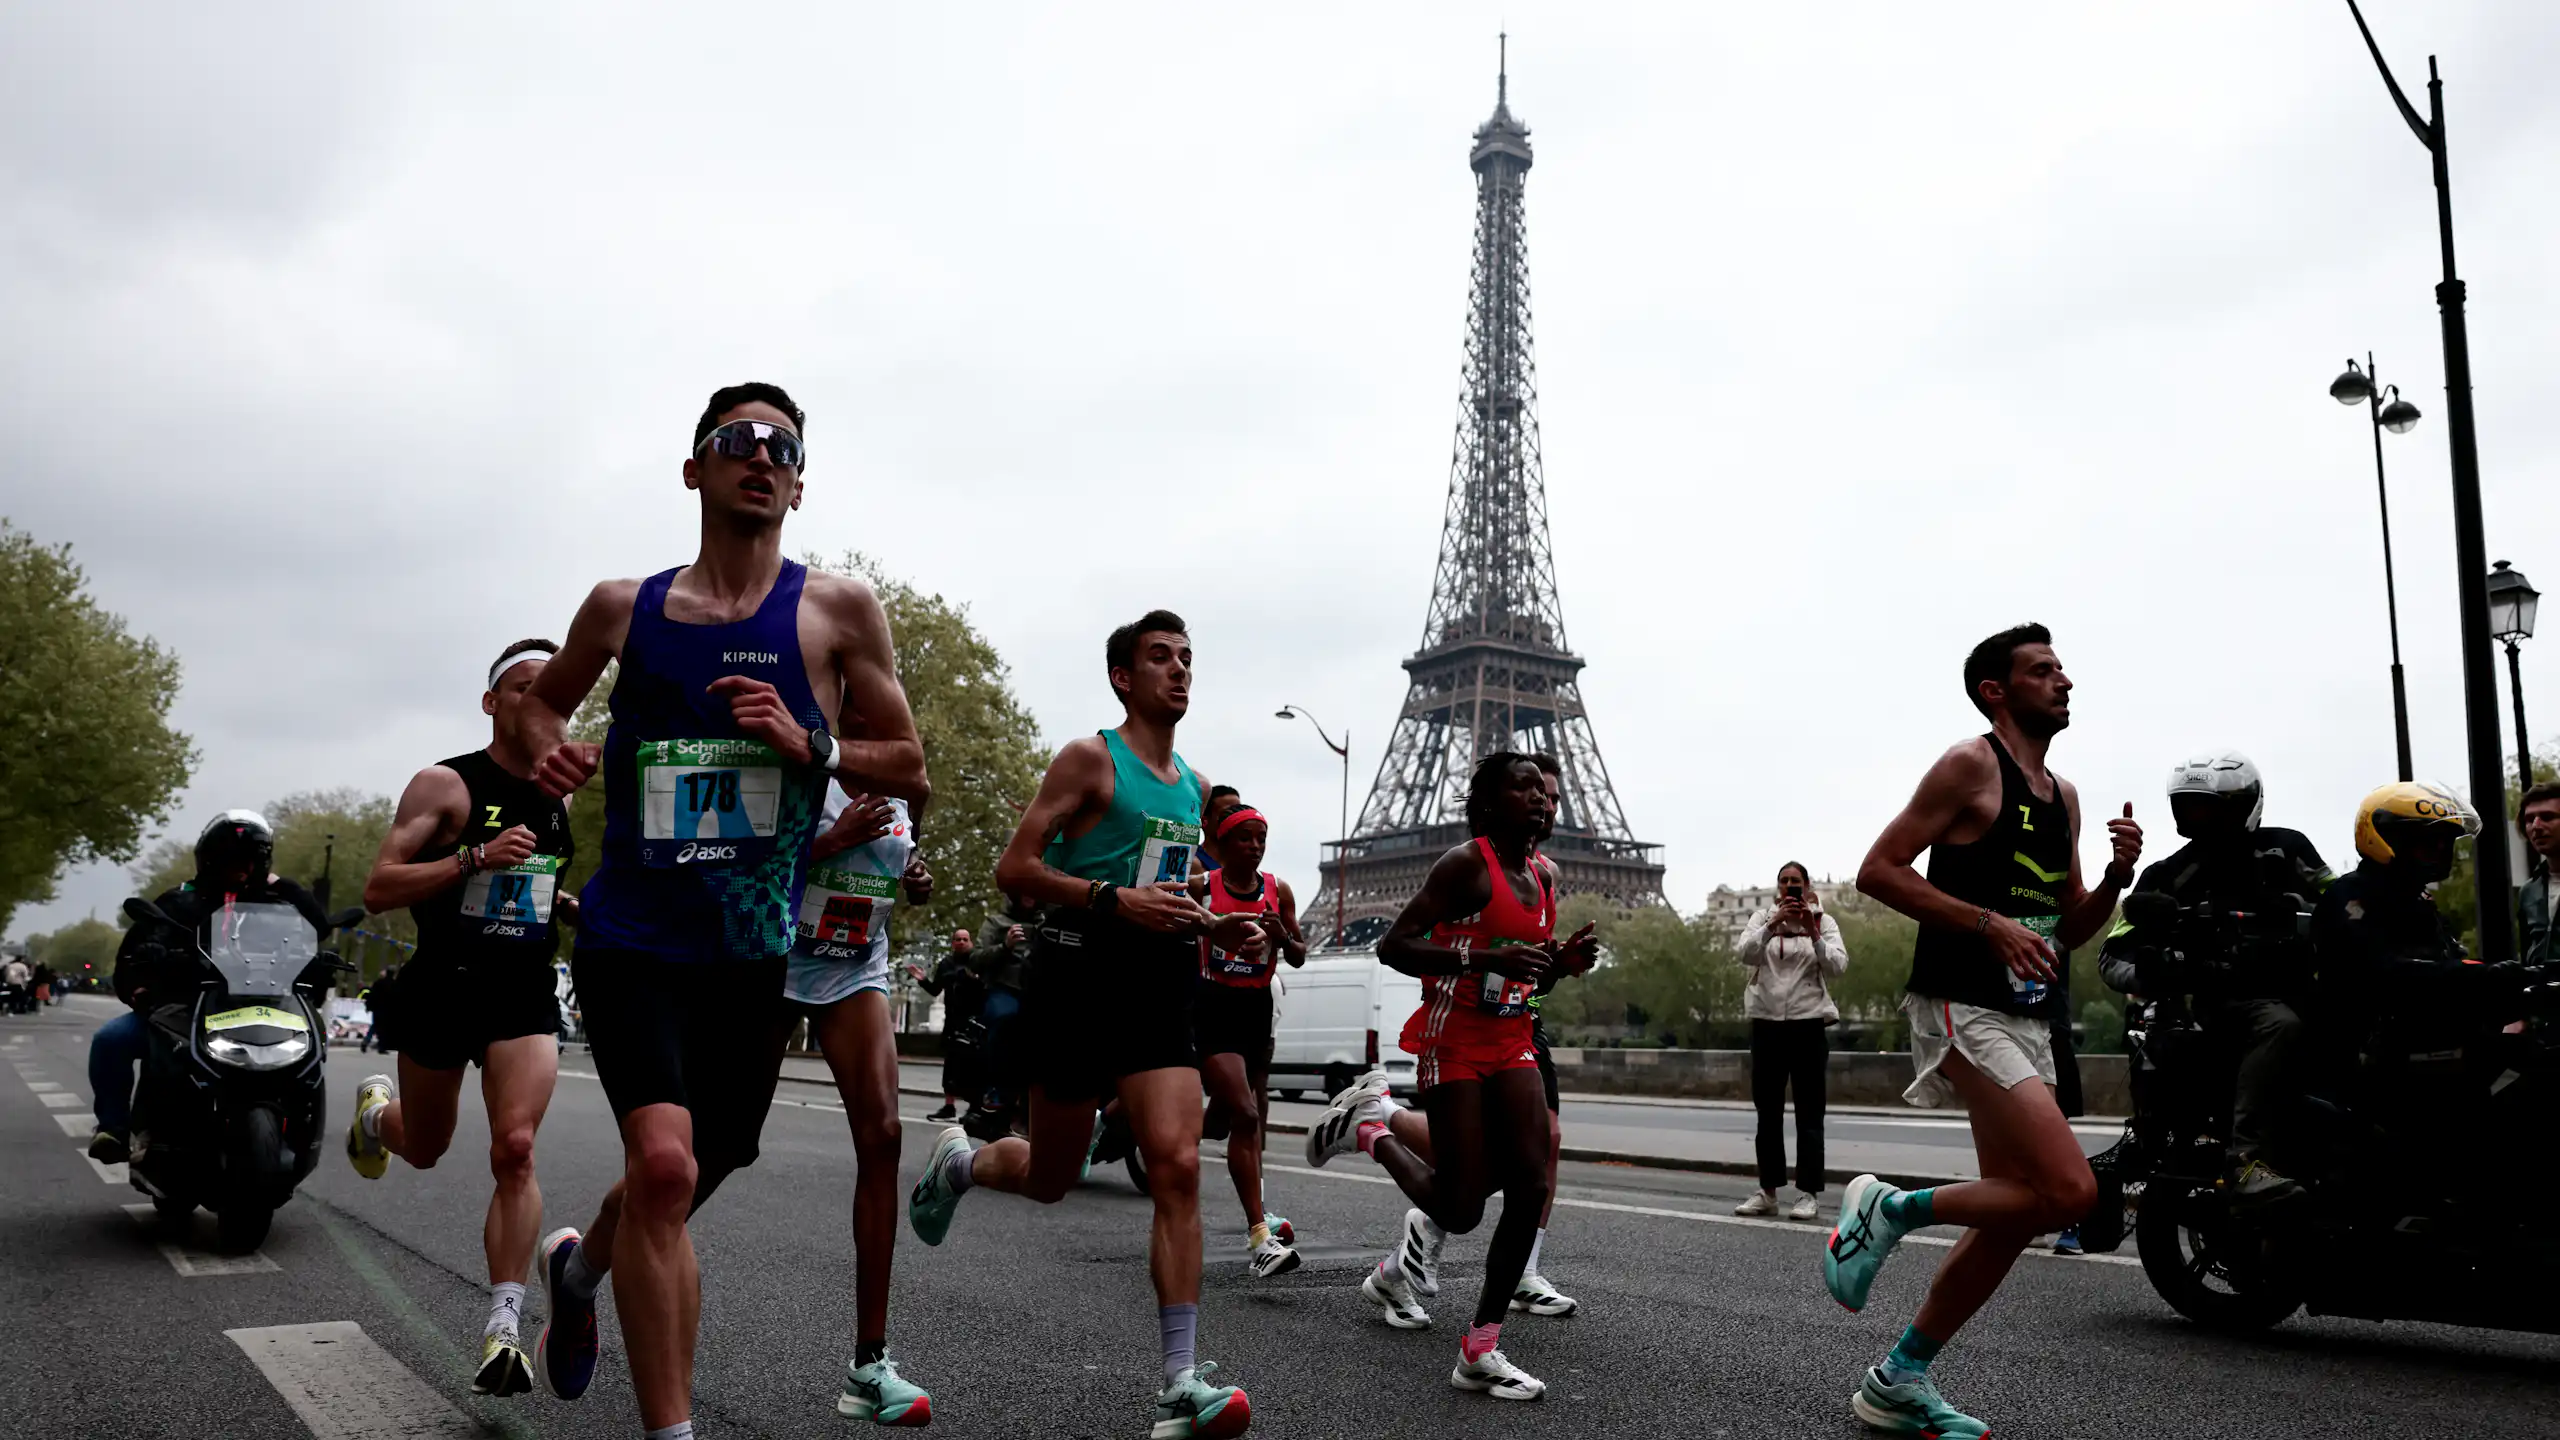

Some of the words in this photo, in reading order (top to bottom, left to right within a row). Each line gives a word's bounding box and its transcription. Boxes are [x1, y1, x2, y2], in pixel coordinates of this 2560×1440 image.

[722, 651, 779, 664] KIPRUN
[676, 739, 767, 756] Schneider
[684, 773, 737, 812] 178
[483, 805, 503, 828] Z
[1166, 846, 1188, 875] 182
[834, 871, 889, 889] Schneider
[856, 885, 887, 896] Electric
[798, 920, 815, 937] 206
[2025, 916, 2058, 929] Schneide
[256, 1007, 271, 1017] 34
